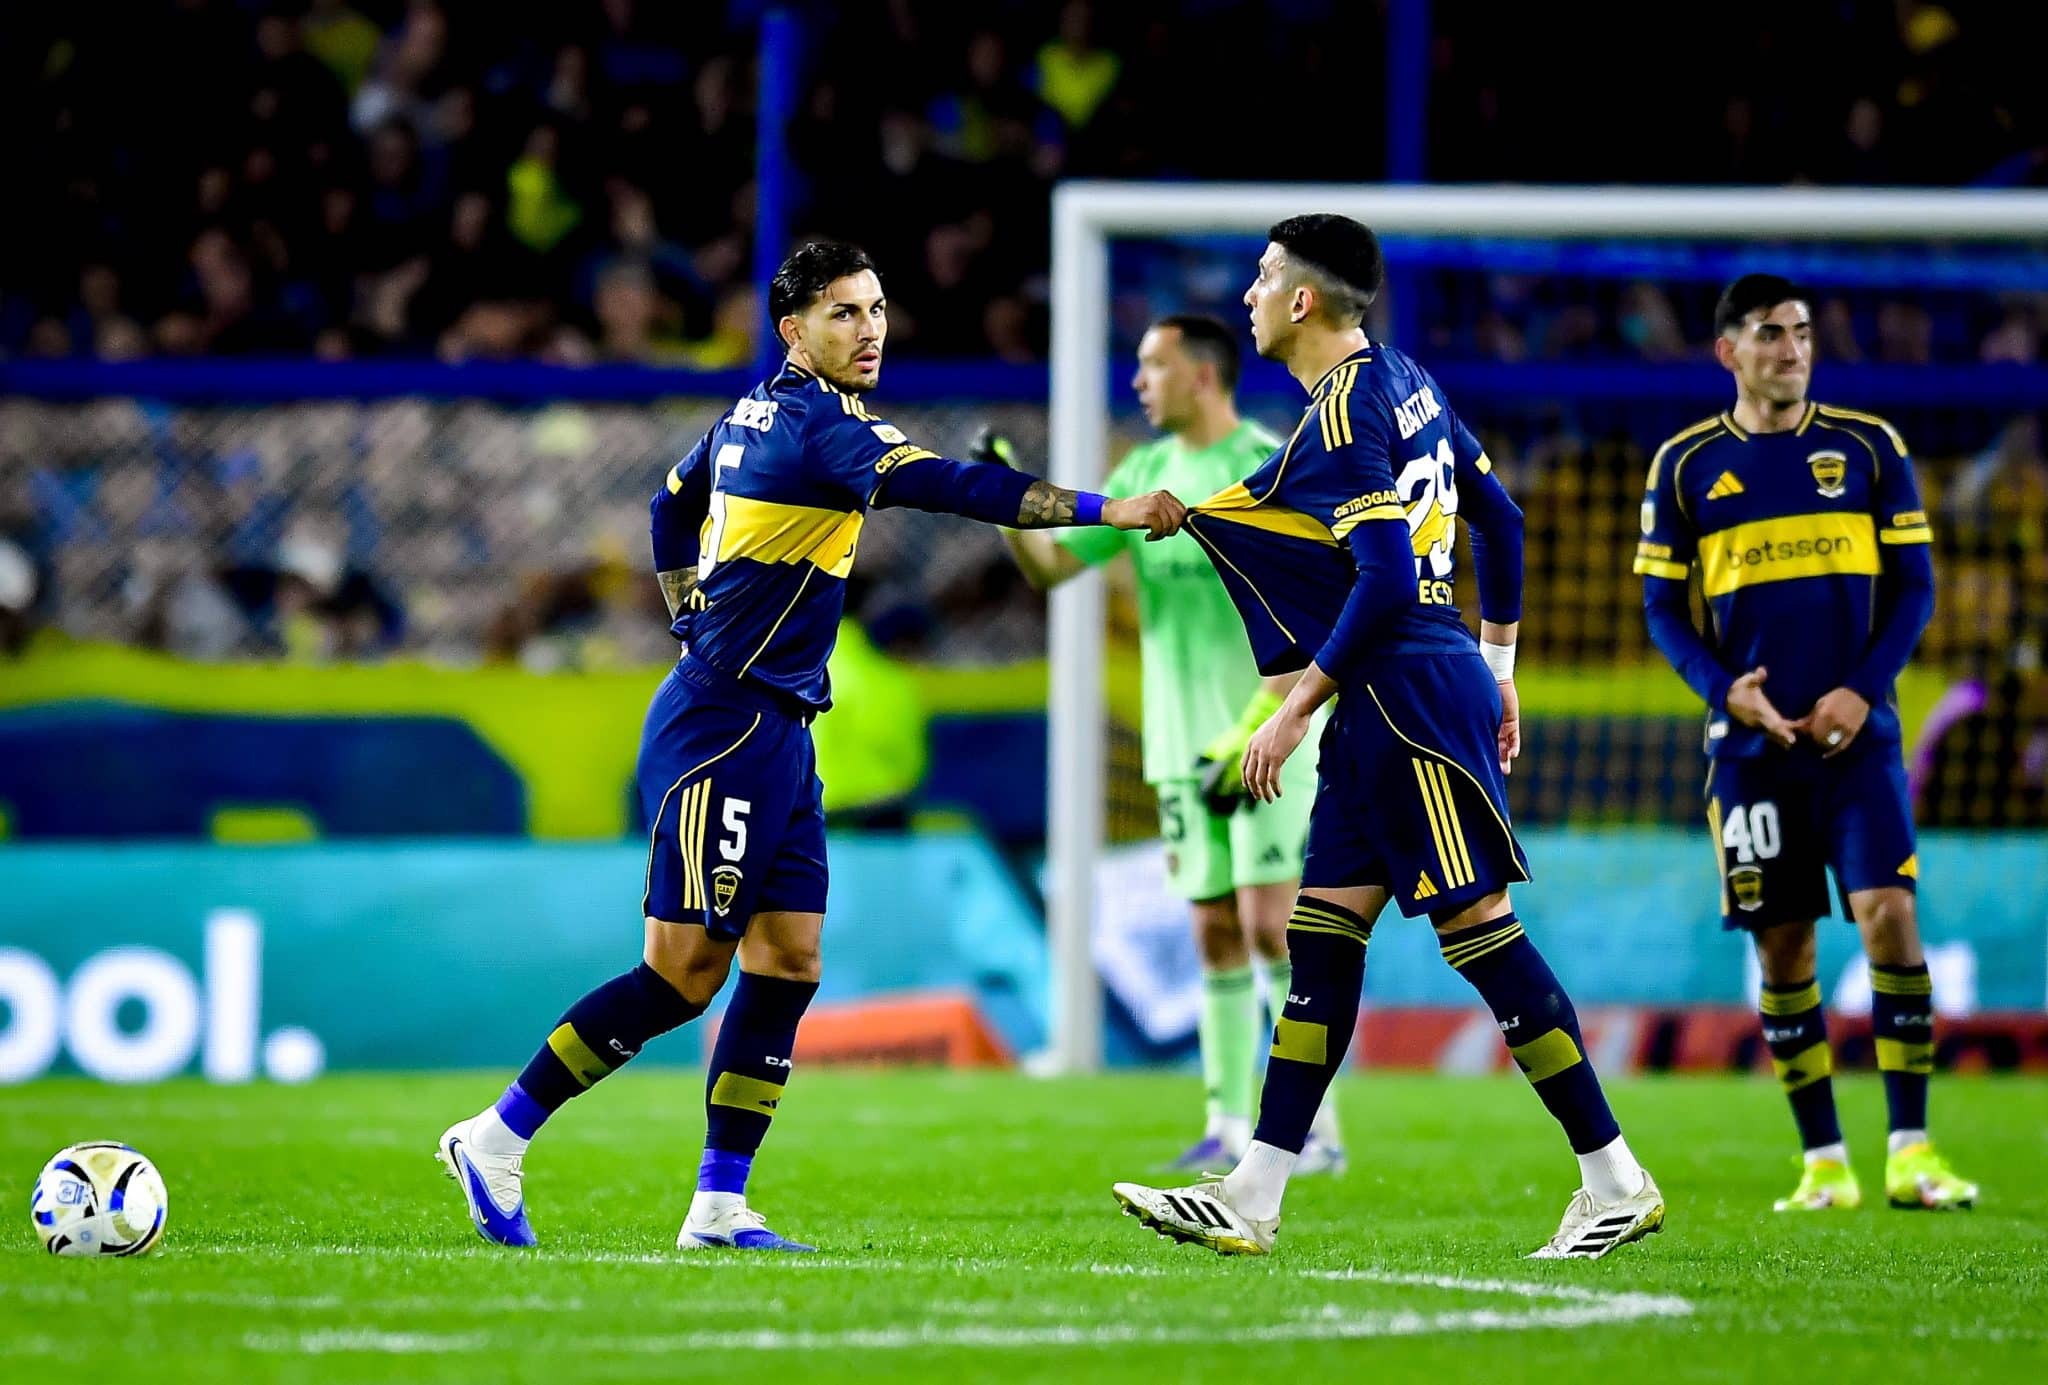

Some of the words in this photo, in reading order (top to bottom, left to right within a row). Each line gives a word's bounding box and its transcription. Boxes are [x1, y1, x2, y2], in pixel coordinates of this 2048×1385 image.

[697, 443, 746, 581] 5
[1395, 437, 1458, 578] 29
[1726, 535, 1853, 570] betsson
[719, 796, 751, 862] 5
[1722, 801, 1781, 863] 40
